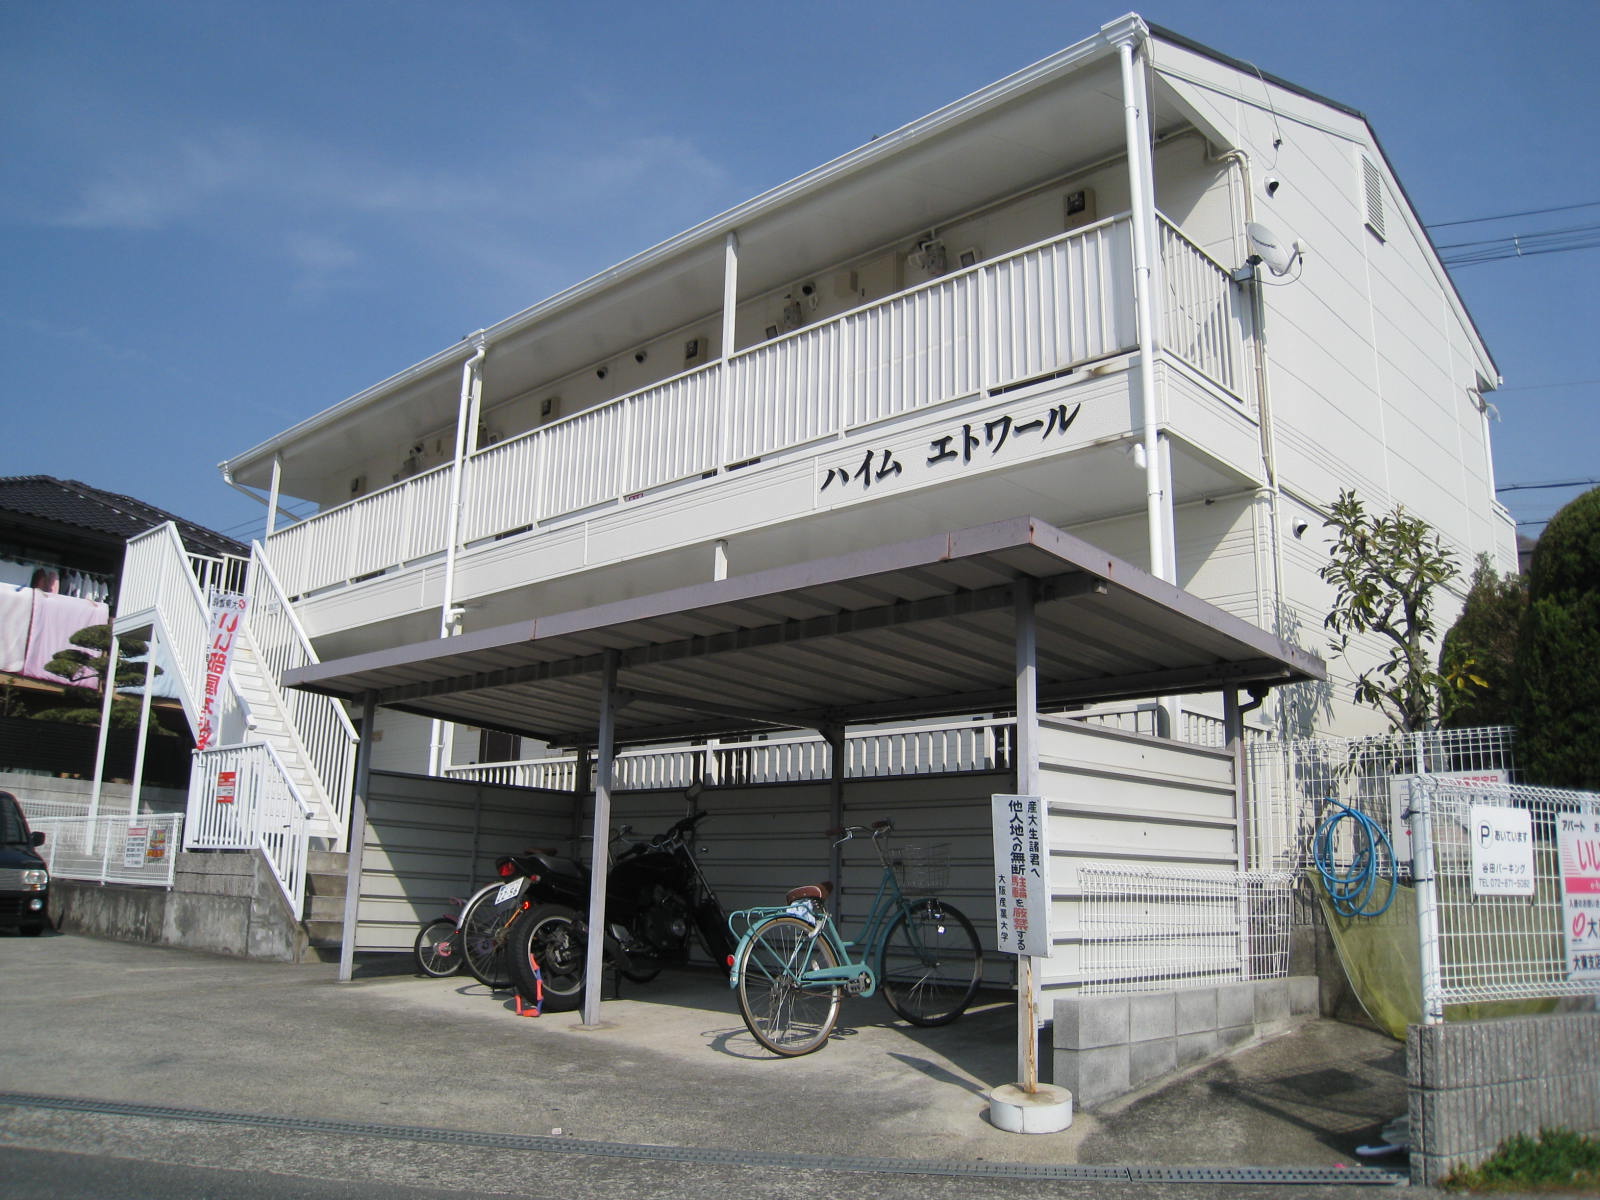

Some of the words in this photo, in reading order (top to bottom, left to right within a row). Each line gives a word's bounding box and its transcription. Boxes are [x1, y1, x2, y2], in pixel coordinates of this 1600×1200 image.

[820, 449, 902, 490] ハイム
[926, 402, 1081, 462] エトワール
[1027, 801, 1040, 878] 産大生諸君へ
[1562, 820, 1585, 832] アパート
